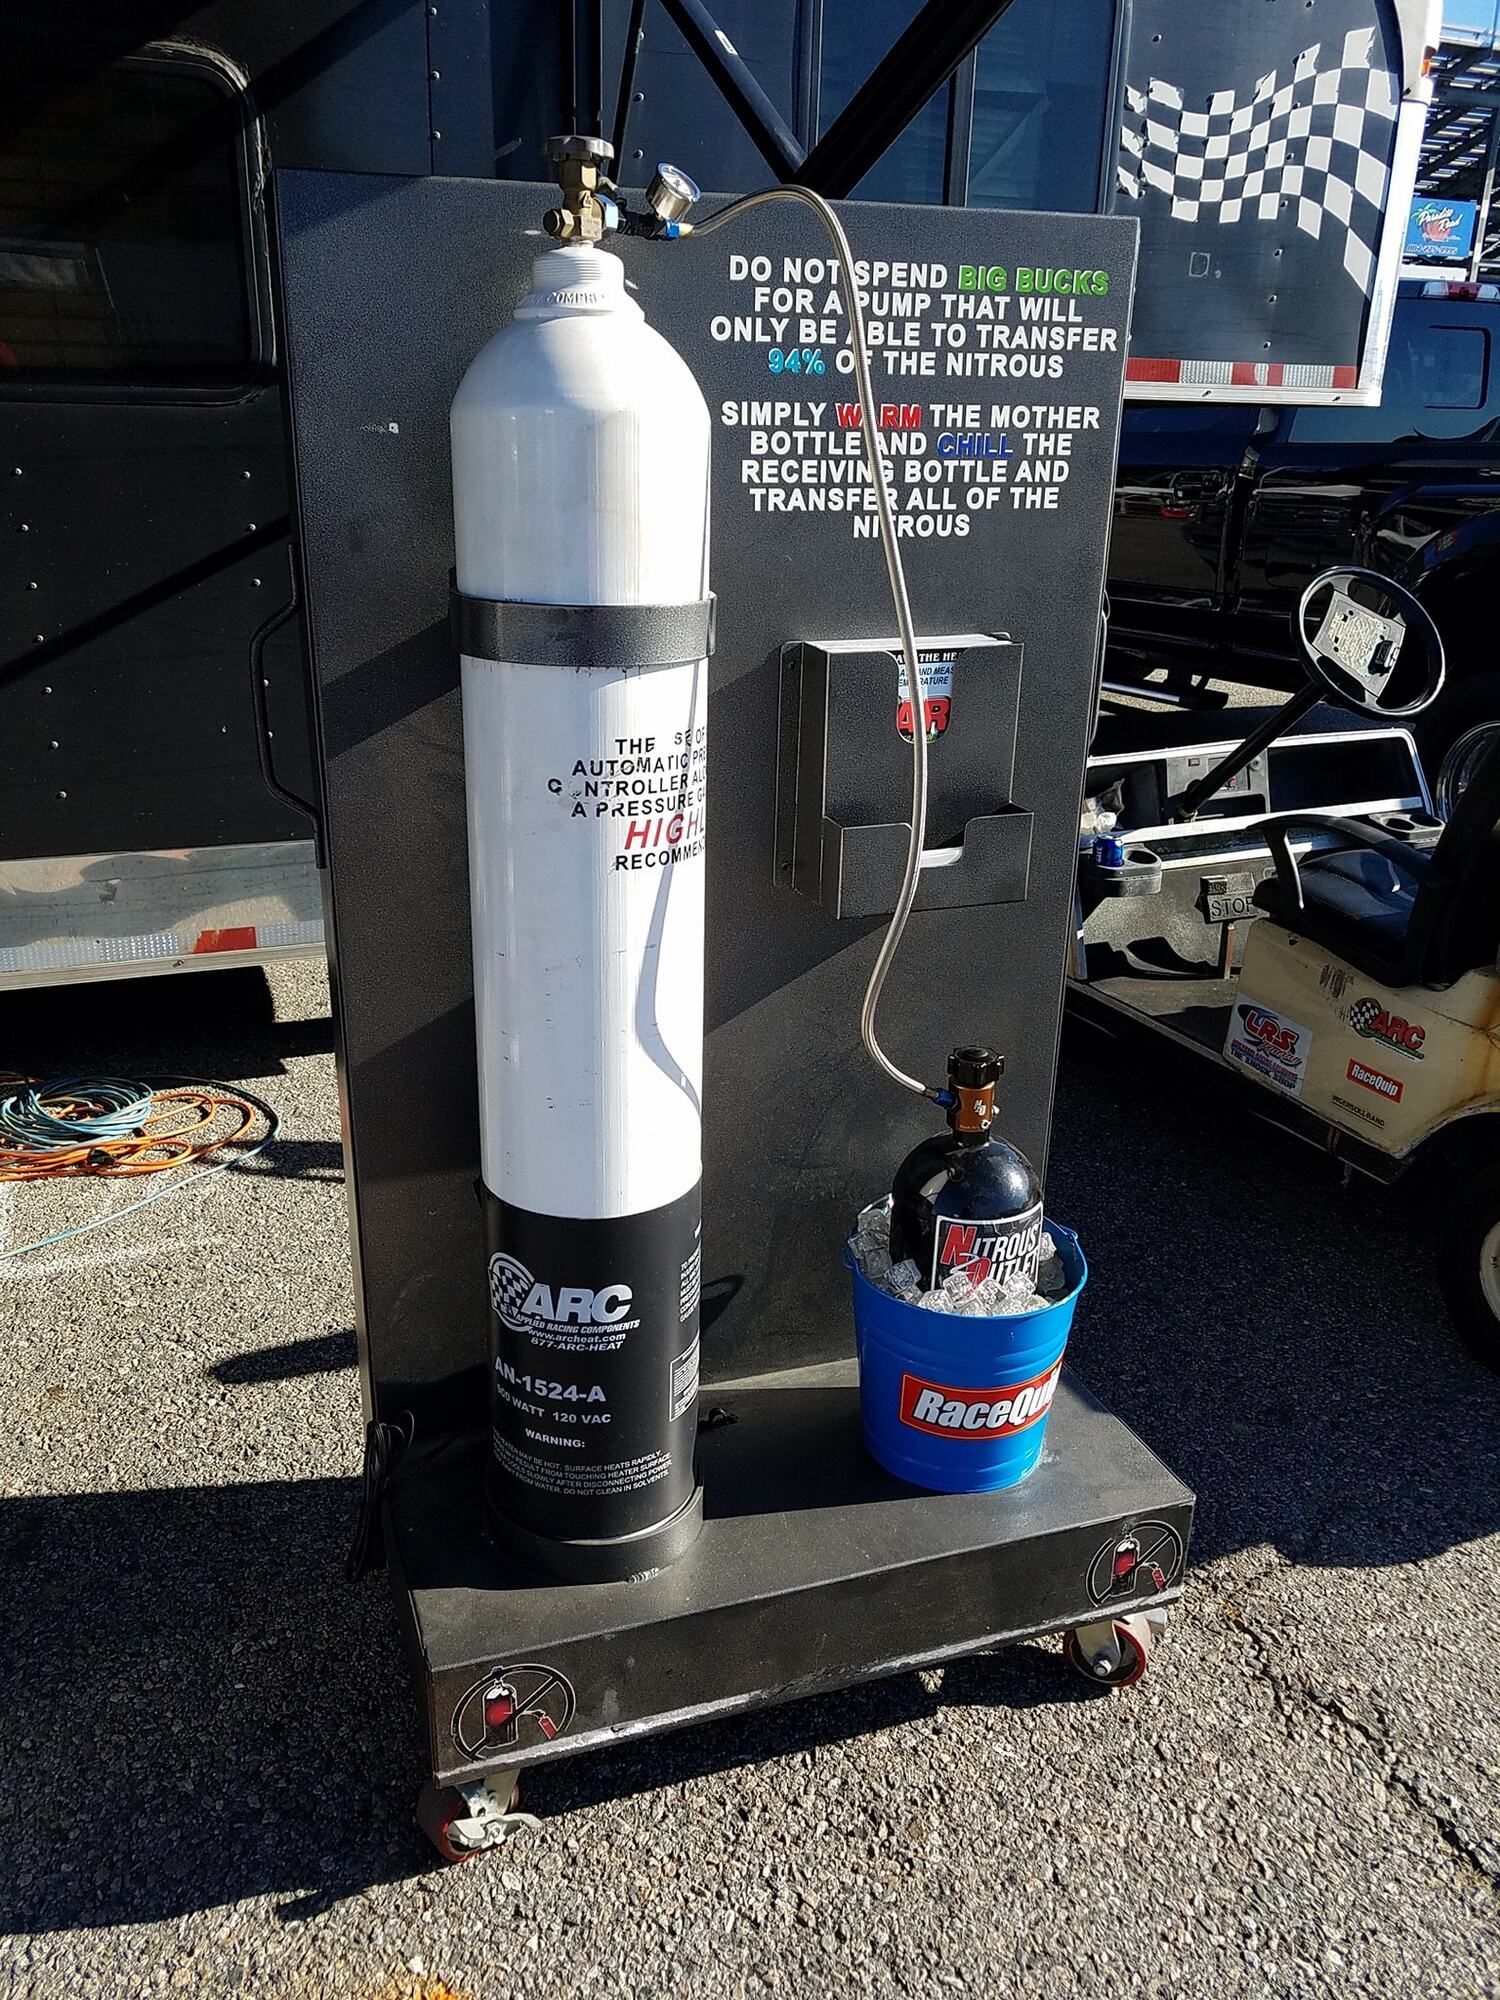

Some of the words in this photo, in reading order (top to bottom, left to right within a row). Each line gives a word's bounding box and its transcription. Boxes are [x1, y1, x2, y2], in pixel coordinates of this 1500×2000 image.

[730, 256, 772, 282] DO
[784, 258, 838, 285] NOT
[854, 260, 948, 288] SPEND
[958, 265, 1007, 293] BIG
[1016, 268, 1110, 296] BUCKS
[754, 287, 814, 314] FOR
[822, 289, 843, 315] A
[859, 290, 931, 319] PUMP
[942, 294, 1010, 320] THAT
[1020, 296, 1083, 323] WILL
[710, 316, 789, 342] ONLY
[800, 318, 836, 344] BE
[846, 320, 920, 346] BLE
[930, 323, 966, 348] TO
[976, 324, 1117, 352] TRANSFER
[768, 348, 826, 375] 94%
[882, 351, 936, 376] THE
[946, 353, 1064, 378] NITROUS
[721, 402, 827, 427] SIMPLY
[835, 403, 922, 429] WRM
[930, 404, 982, 428] THE
[991, 405, 1100, 429] MOTHER
[750, 432, 861, 456] BOTTLE
[937, 432, 1014, 457] CHILL
[1023, 434, 1072, 456] THE
[742, 460, 894, 484] RECEIVING
[904, 461, 1007, 484] BOTTLE
[1014, 460, 1070, 483] AND
[750, 488, 899, 512] TRANSFER
[906, 488, 956, 510] ALL
[966, 488, 1003, 510] OF
[1010, 487, 1058, 509] THE
[854, 515, 970, 538] NIROUS
[919, 652, 940, 662] THE
[942, 652, 961, 662] HE
[615, 737, 656, 754] THE
[572, 753, 688, 776] AUTOMATIC
[548, 773, 688, 798] CNTROLLER
[571, 802, 586, 818] A
[596, 791, 694, 818] PRESSURE
[1245, 1010, 1299, 1051] LRS
[1368, 1010, 1426, 1050] ARC
[1352, 1064, 1399, 1096] RaceQuip
[940, 1222, 1040, 1265] NITROUS
[520, 1282, 633, 1323] ARC
[516, 1313, 546, 1329] APPLIED
[546, 1322, 578, 1334] RACING
[580, 1319, 640, 1334] COMPONENTS
[528, 1328, 626, 1343] www.archeat.com
[530, 1336, 624, 1352] 877-ARC-HEAT
[495, 1356, 606, 1402] AN-1524-A
[512, 1396, 544, 1418] WATT
[552, 1412, 577, 1423] 120
[581, 1414, 612, 1424] VAC
[524, 1428, 586, 1448] WARNING:
[564, 1464, 602, 1472] SURFACE
[604, 1460, 630, 1471] HEATS
[564, 1472, 606, 1480] TOUCHING
[608, 1466, 639, 1478] HEATER
[556, 1480, 582, 1488] AFTER
[584, 1472, 647, 1488] DISCONNECTING
[576, 1488, 594, 1496] NOT
[595, 1486, 622, 1495] CLEAN
[624, 1483, 632, 1492] IN
